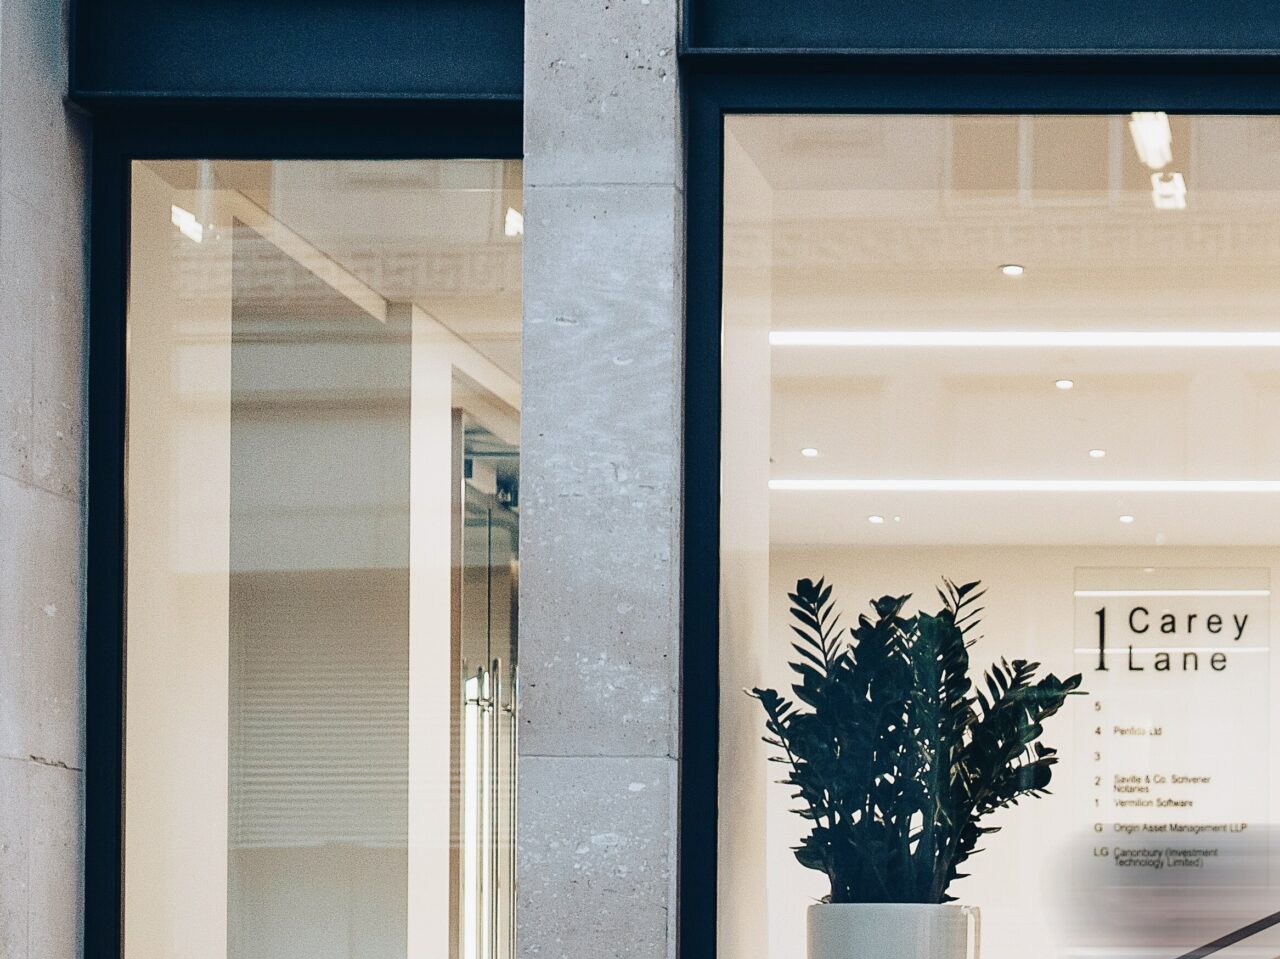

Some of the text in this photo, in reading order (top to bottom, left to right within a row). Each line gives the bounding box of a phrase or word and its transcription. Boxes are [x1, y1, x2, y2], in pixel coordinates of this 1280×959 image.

[1095, 606, 1249, 671] 1 Carey
[1128, 645, 1228, 671] Lane
[1094, 702, 1102, 711] 5
[1094, 727, 1102, 736] 4
[1094, 752, 1101, 761] 3
[1094, 777, 1101, 786] 2
[1156, 799, 1193, 807] Software
[1094, 823, 1103, 832] G
[1114, 823, 1140, 834] Origin
[1142, 823, 1167, 832] Asset
[1169, 823, 1227, 835] Management
[1093, 847, 1109, 856] LG
[1114, 857, 1163, 869] Technology
